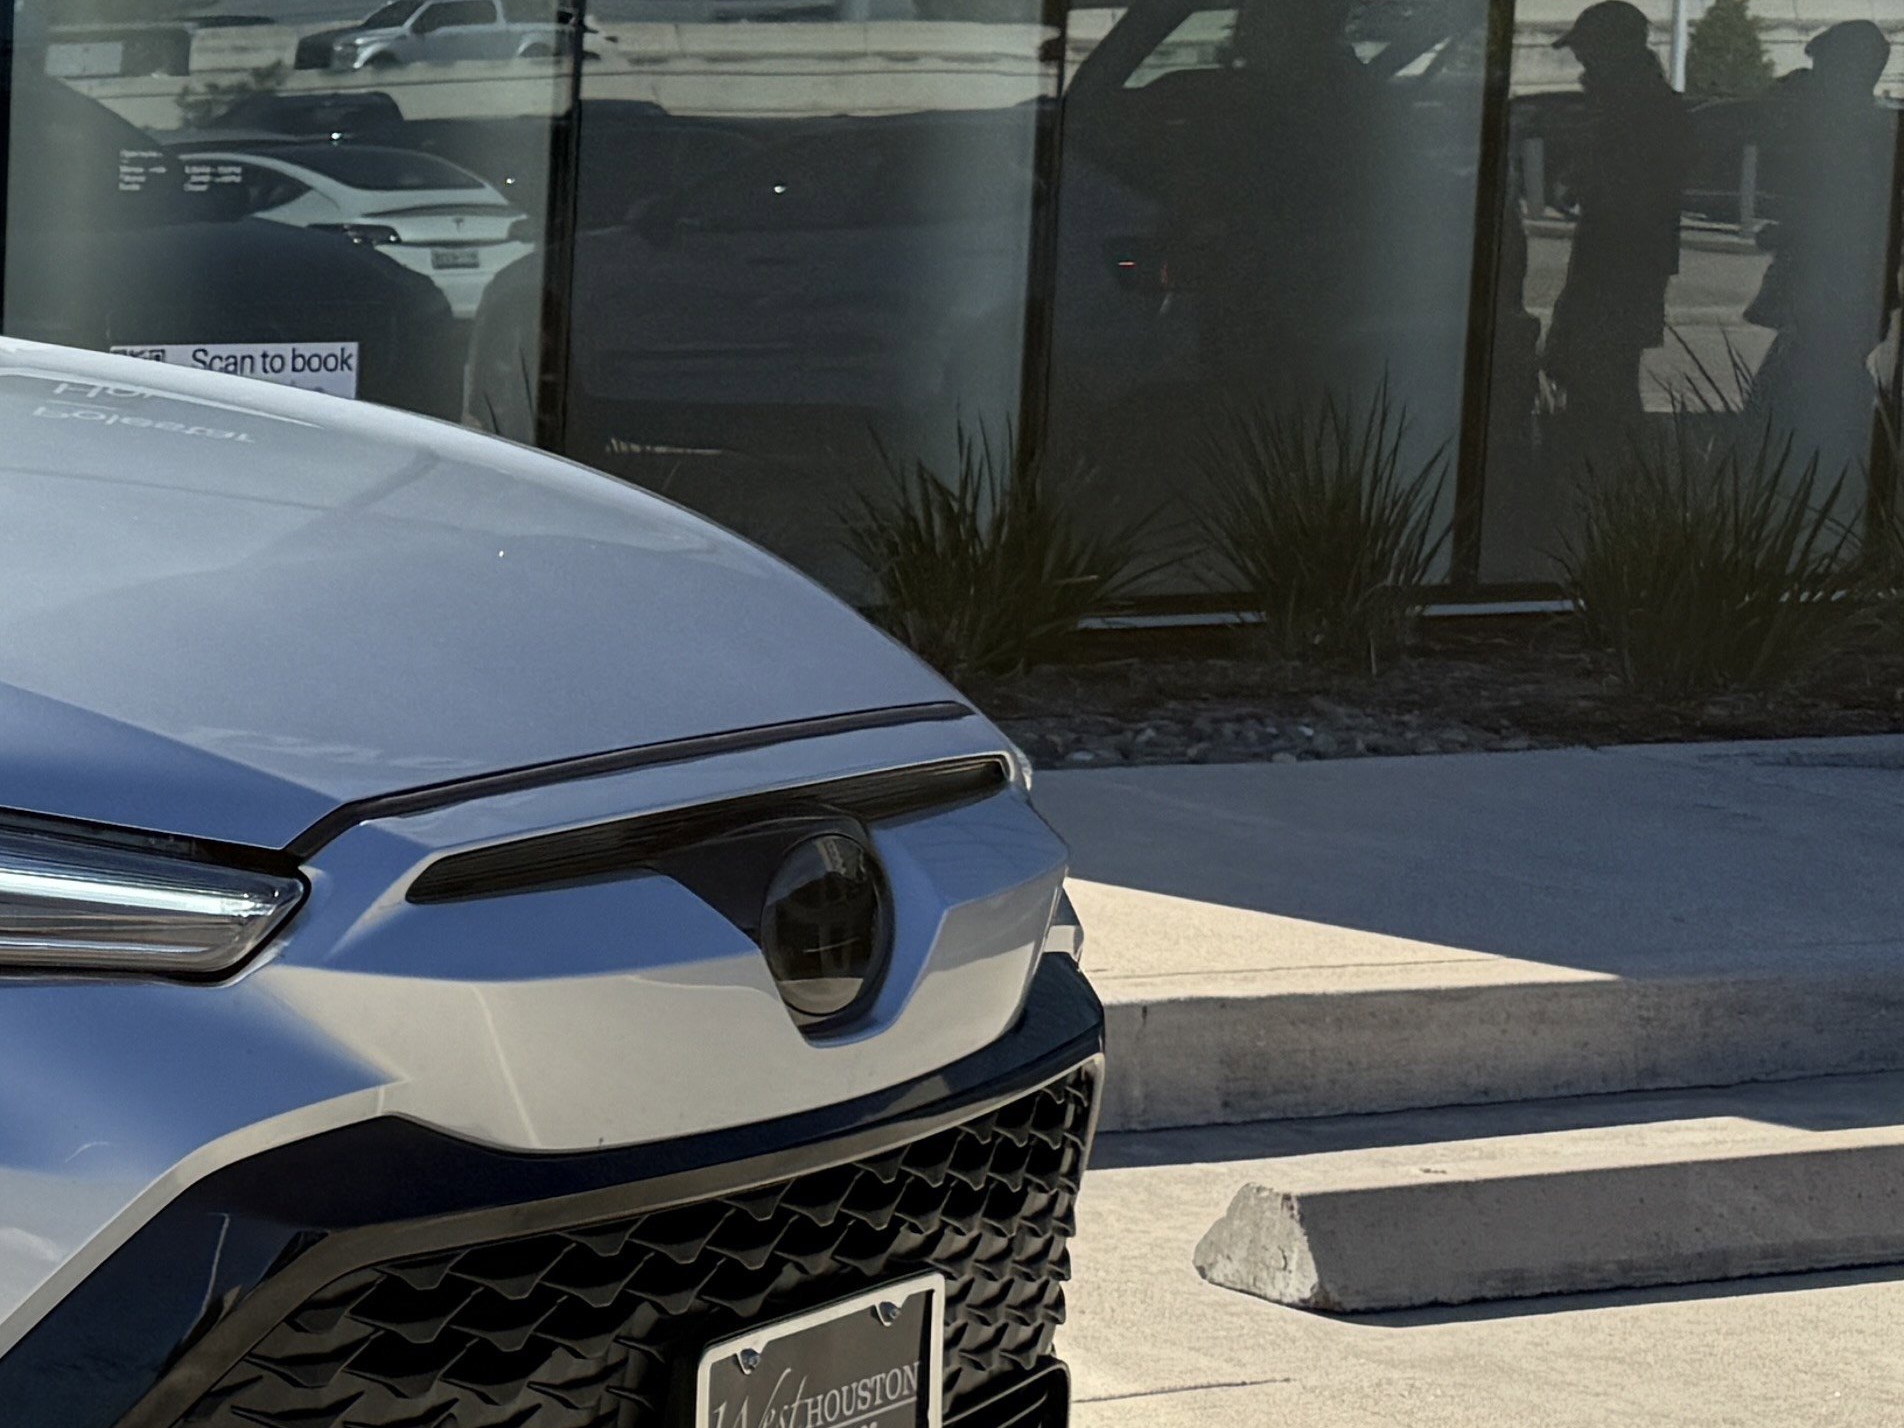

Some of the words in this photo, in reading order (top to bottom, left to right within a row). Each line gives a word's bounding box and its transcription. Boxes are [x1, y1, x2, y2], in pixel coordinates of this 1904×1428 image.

[192, 348, 254, 373] Scan
[261, 353, 284, 374] to
[291, 348, 352, 373] book
